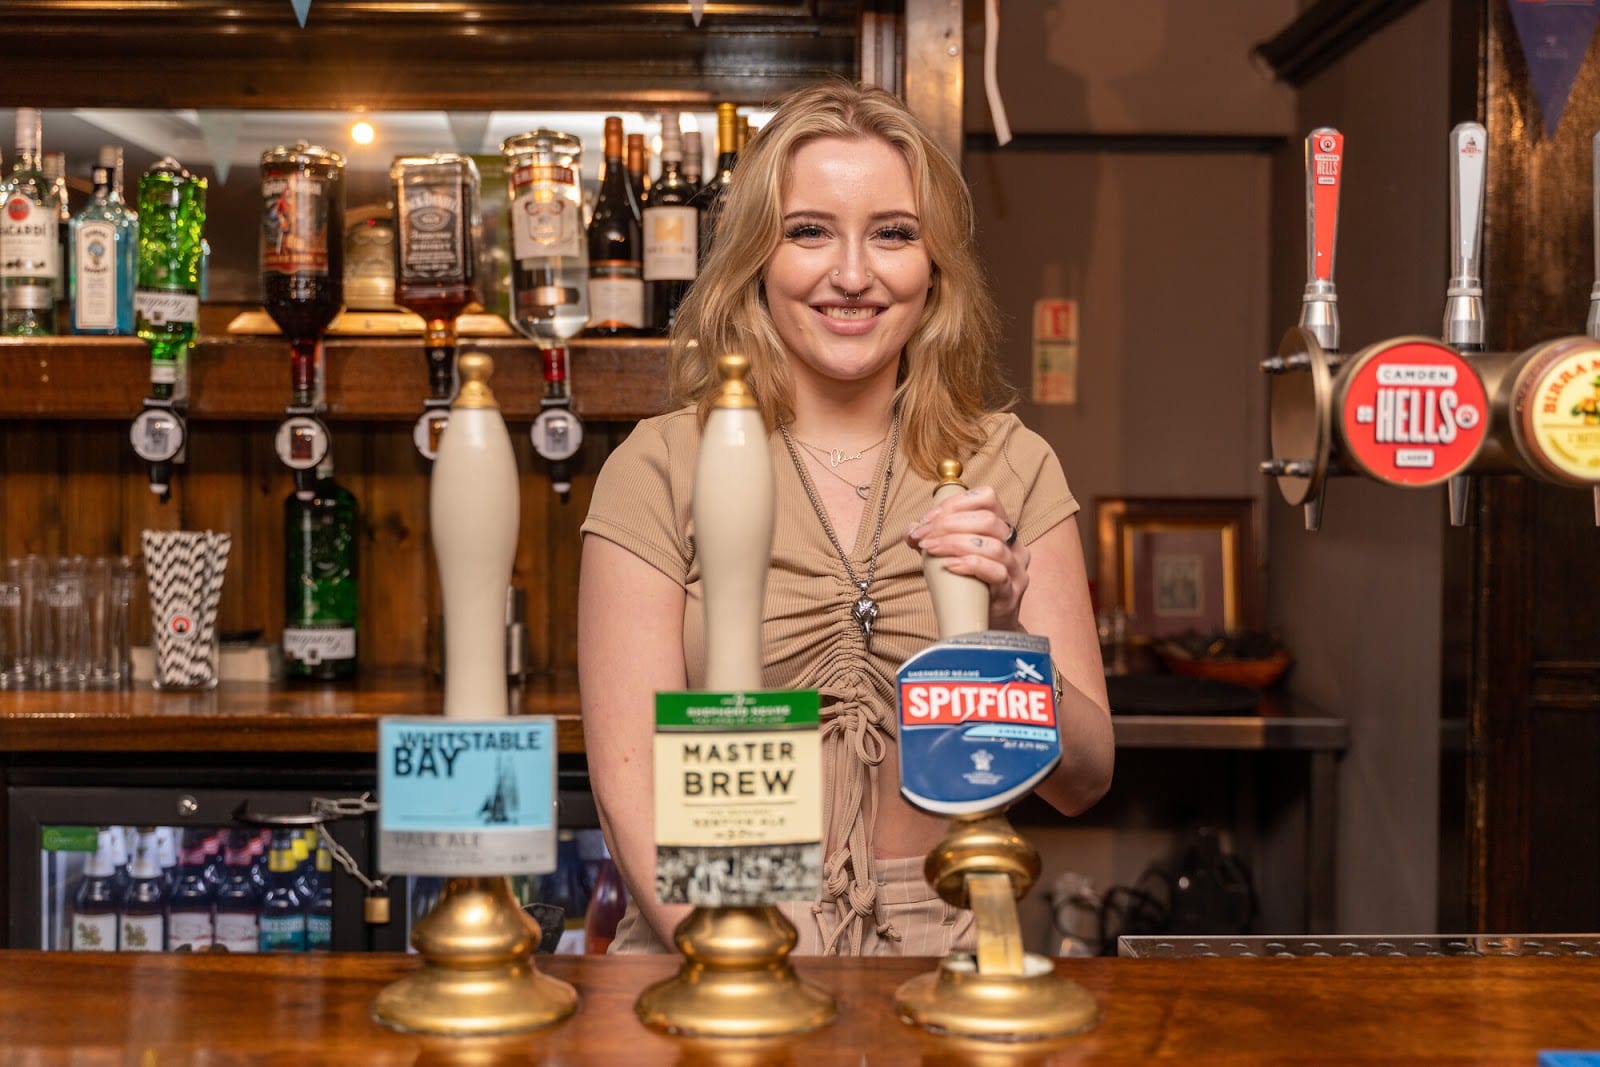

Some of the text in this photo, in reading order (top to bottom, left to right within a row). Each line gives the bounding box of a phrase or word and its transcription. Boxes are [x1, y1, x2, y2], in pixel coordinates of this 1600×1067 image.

[1317, 161, 1337, 175] HELLS
[1383, 369, 1449, 380] CAMDEN
[1543, 364, 1587, 413] BIRRA
[1377, 388, 1458, 444] HELLS
[908, 684, 1048, 721] SPITFIRE
[400, 731, 541, 750] WHITSTABLE
[683, 742, 794, 763] MASTER
[395, 747, 461, 777] BAY
[685, 771, 794, 796] BREW
